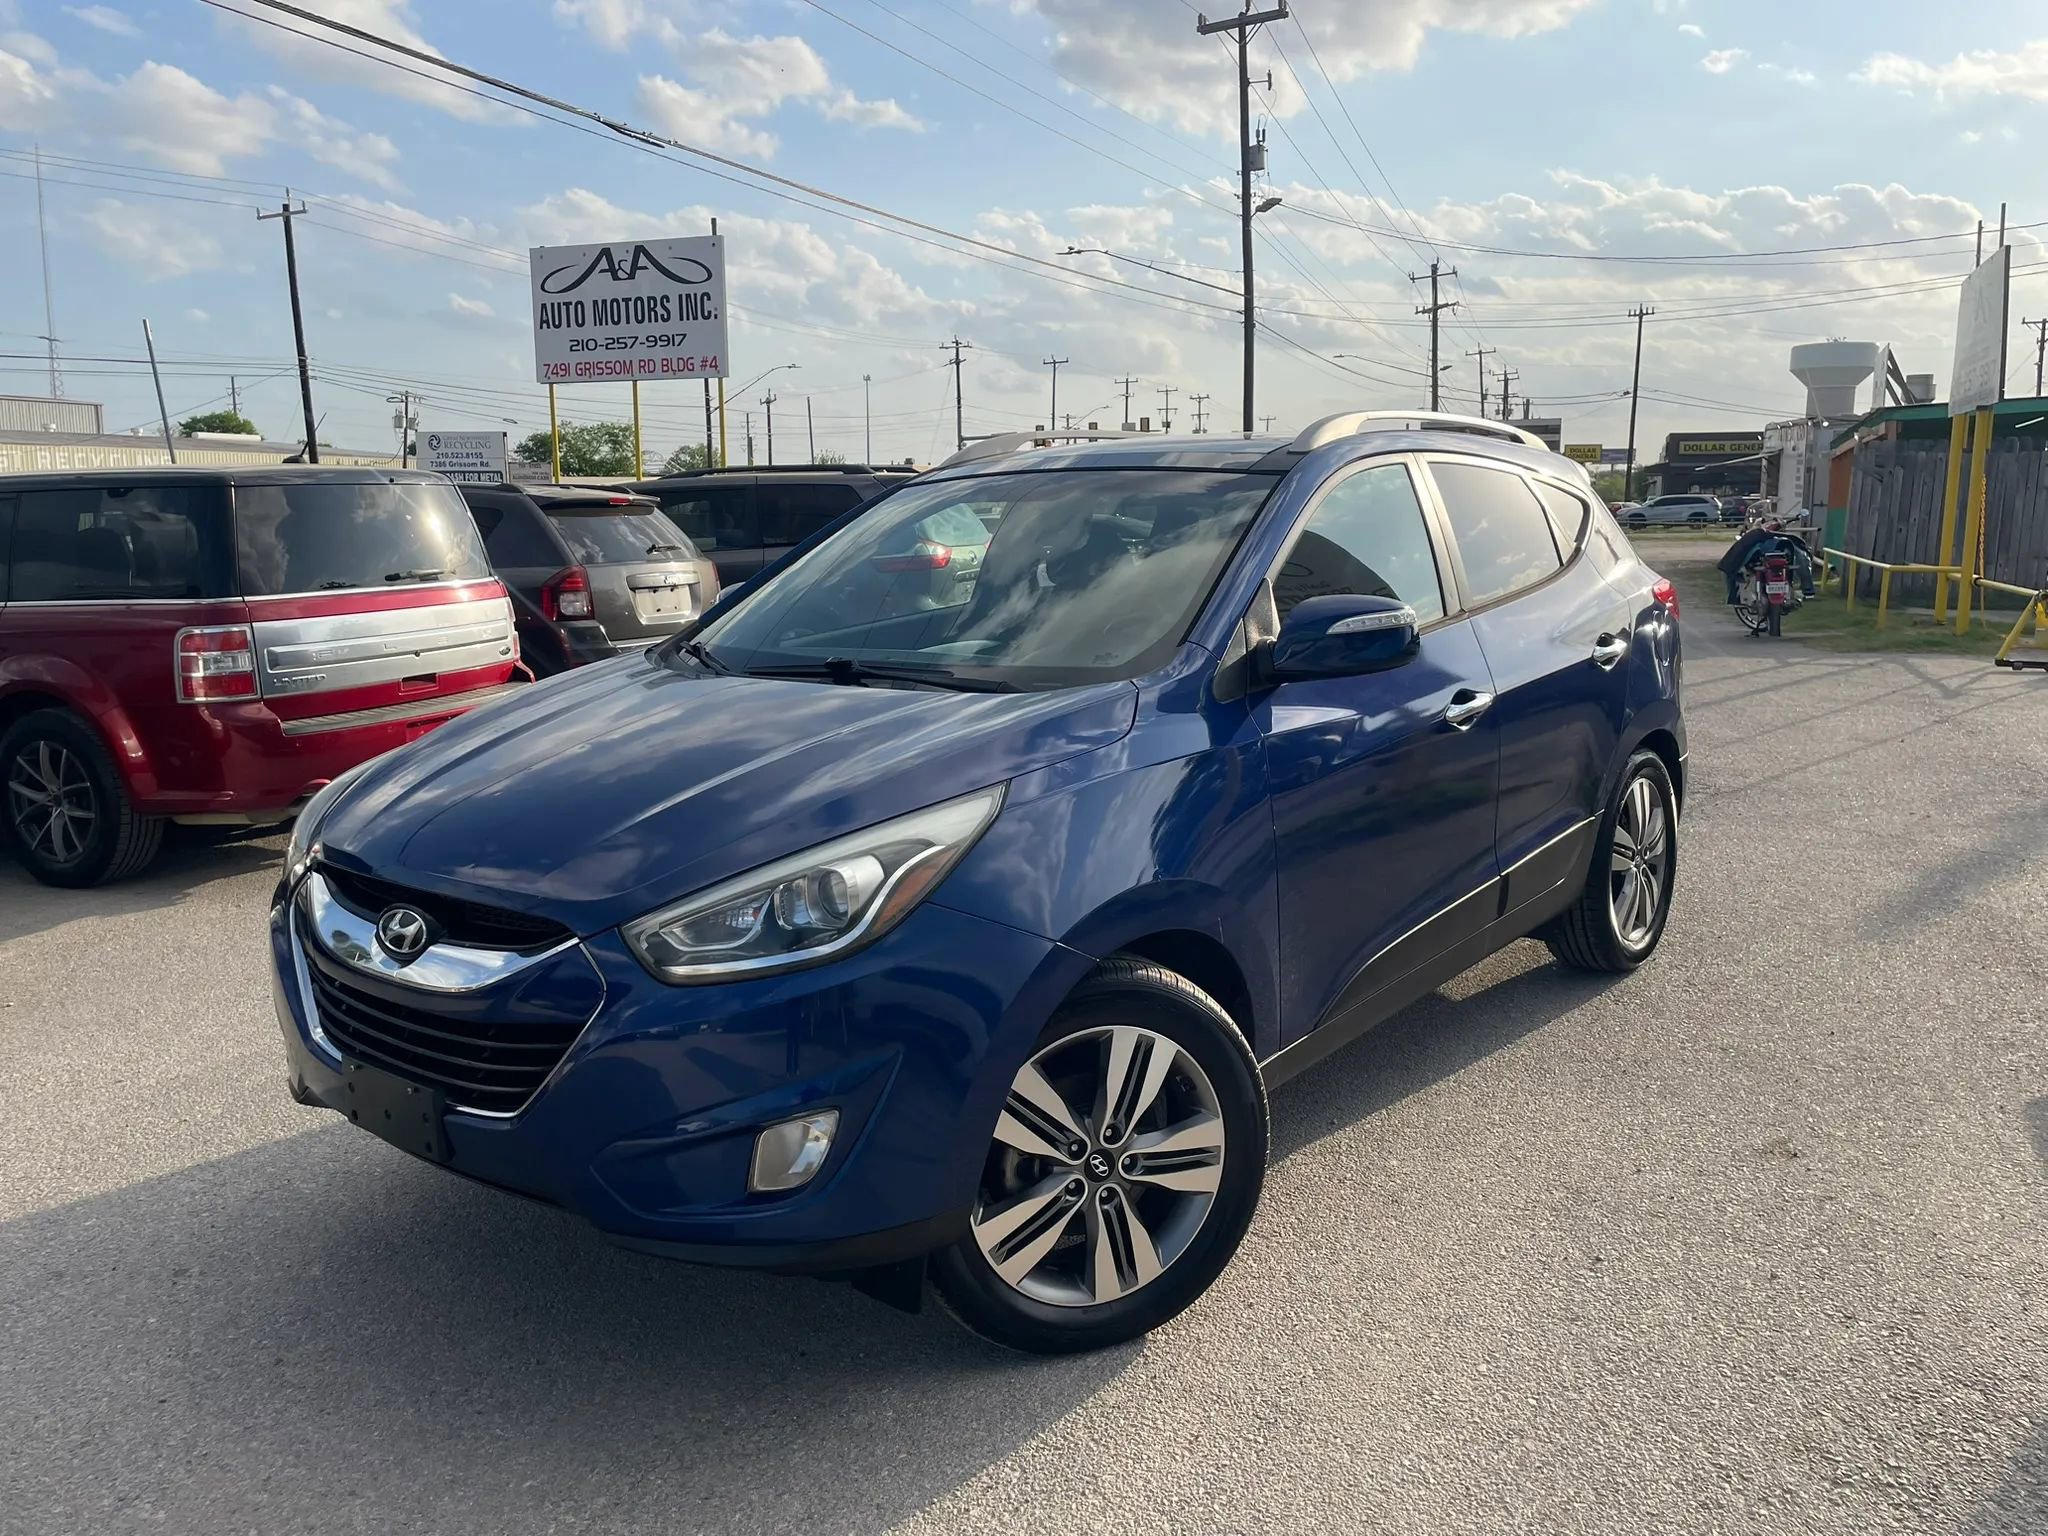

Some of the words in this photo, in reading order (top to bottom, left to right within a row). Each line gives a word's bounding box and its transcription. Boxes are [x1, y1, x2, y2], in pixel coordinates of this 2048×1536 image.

[539, 300, 586, 329] AUTO
[593, 294, 671, 326] MOTORS
[678, 291, 718, 322] INC.
[569, 333, 687, 352] 210-257-9917
[543, 362, 571, 378] 7491
[575, 359, 634, 377] GRISSOM
[638, 358, 656, 374] RD
[661, 356, 695, 374] BLDG
[700, 355, 718, 372] #4
[443, 440, 492, 450] RECYCLING
[1683, 444, 1726, 452] DOLLAR
[436, 451, 484, 460] 210.523.8155
[448, 460, 478, 468] Grissom
[448, 473, 464, 482] ASH
[465, 473, 479, 482] FOR
[480, 473, 503, 482] METAL
